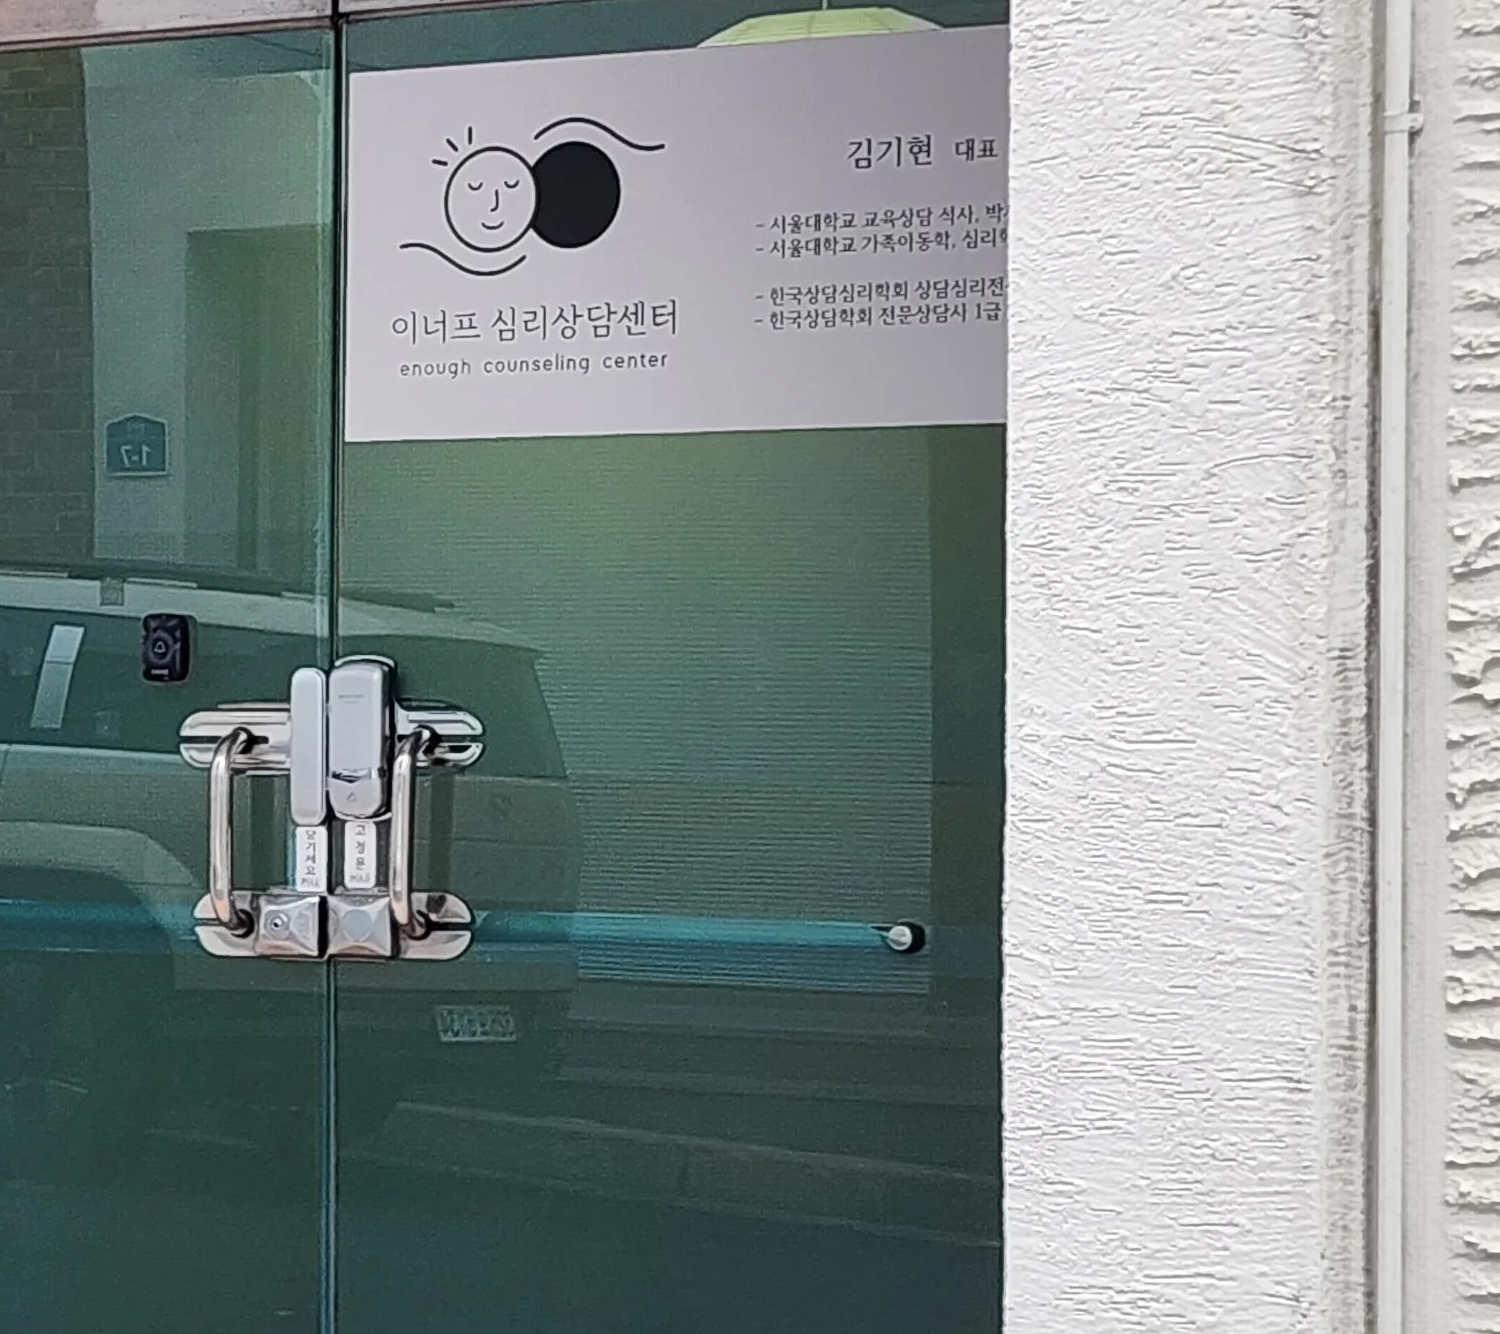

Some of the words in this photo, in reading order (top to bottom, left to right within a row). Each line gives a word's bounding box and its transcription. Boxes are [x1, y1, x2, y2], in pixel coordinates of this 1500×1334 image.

[847, 134, 933, 169] 김기현
[954, 138, 999, 162] 대표
[862, 207, 933, 228] 교육상담
[391, 310, 482, 345] 이너프
[490, 299, 677, 342] 심리상담센터
[400, 358, 471, 379] enough
[483, 352, 590, 375] counseling
[602, 351, 668, 370] center
[304, 829, 317, 876] 당기세요
